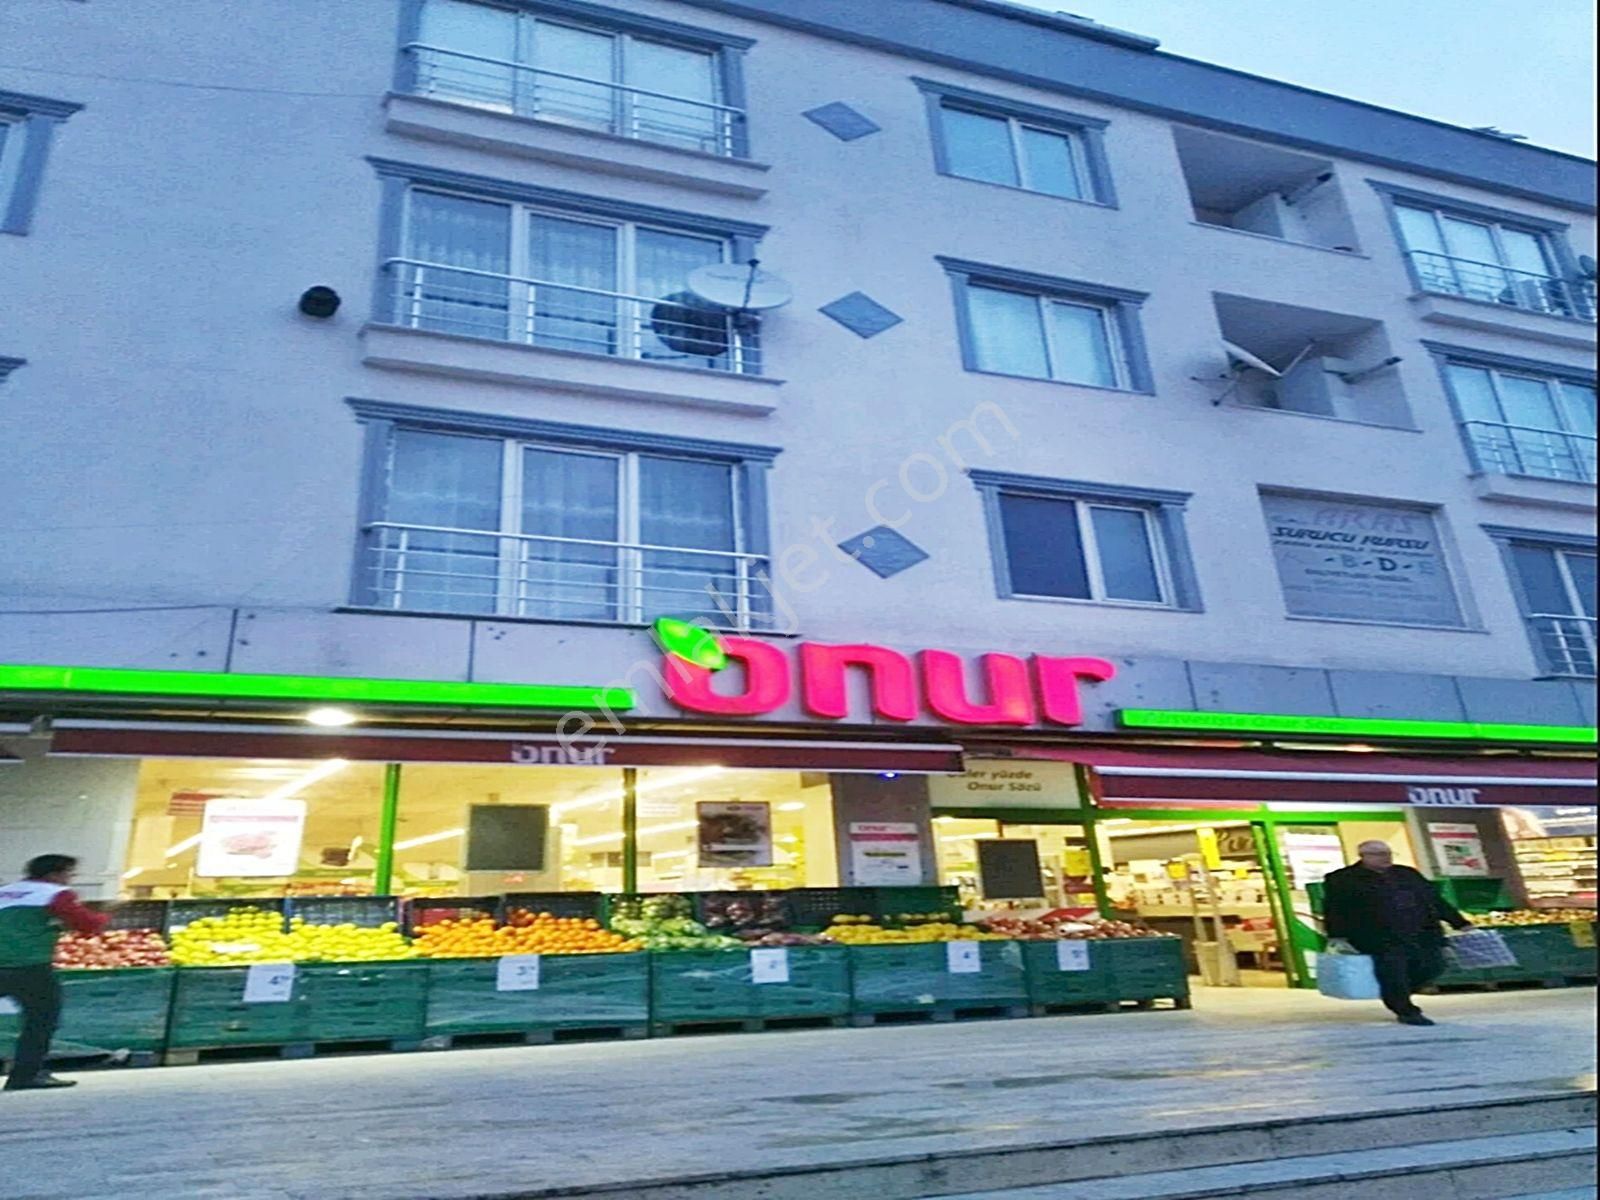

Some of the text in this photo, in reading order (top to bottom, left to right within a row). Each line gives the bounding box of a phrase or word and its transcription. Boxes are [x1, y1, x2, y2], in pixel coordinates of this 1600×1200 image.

[659, 633, 1116, 727] onur
[991, 769, 1033, 781] yüzde
[967, 780, 1043, 792] Onur Sözü
[1408, 786, 1482, 804] onur
